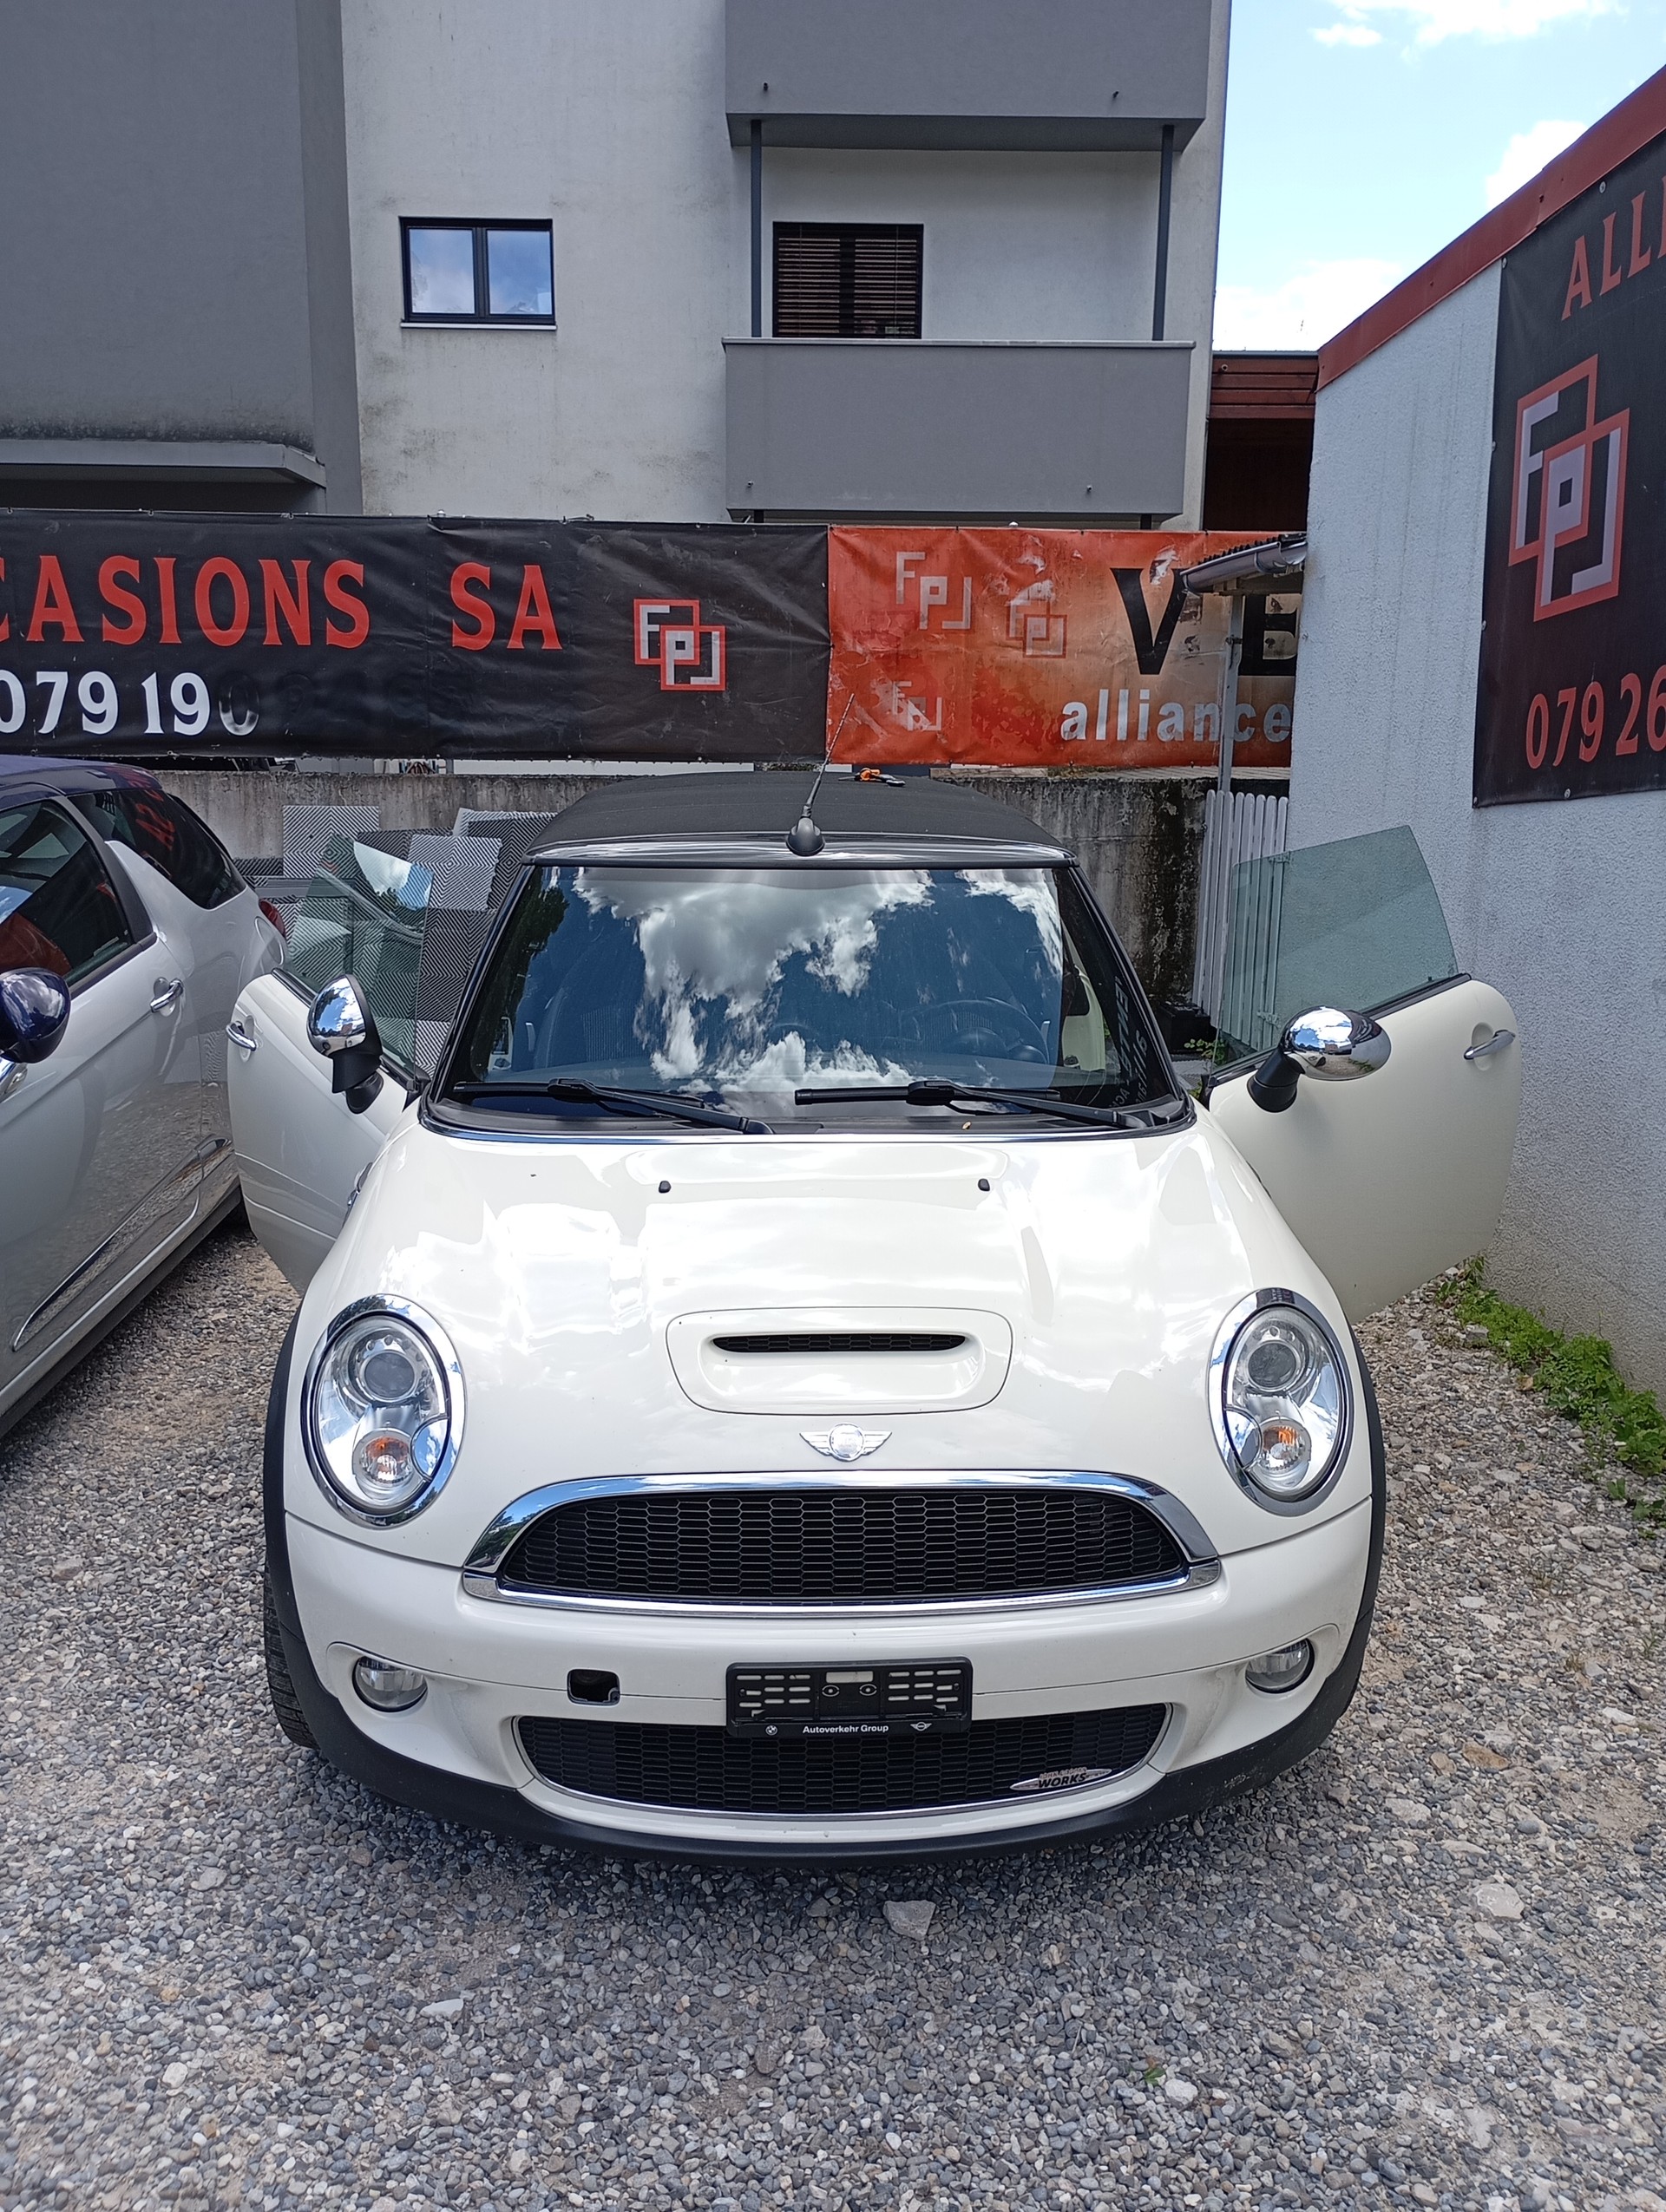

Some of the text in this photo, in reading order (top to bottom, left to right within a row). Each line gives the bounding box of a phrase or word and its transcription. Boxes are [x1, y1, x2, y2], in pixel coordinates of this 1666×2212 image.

[0, 554, 563, 651] ASIONS SA
[0, 669, 120, 736] 079
[1525, 664, 1666, 769] 079 26
[803, 1724, 889, 1734] Autoverkehr Group
[1039, 1772, 1087, 1788] WORKS
